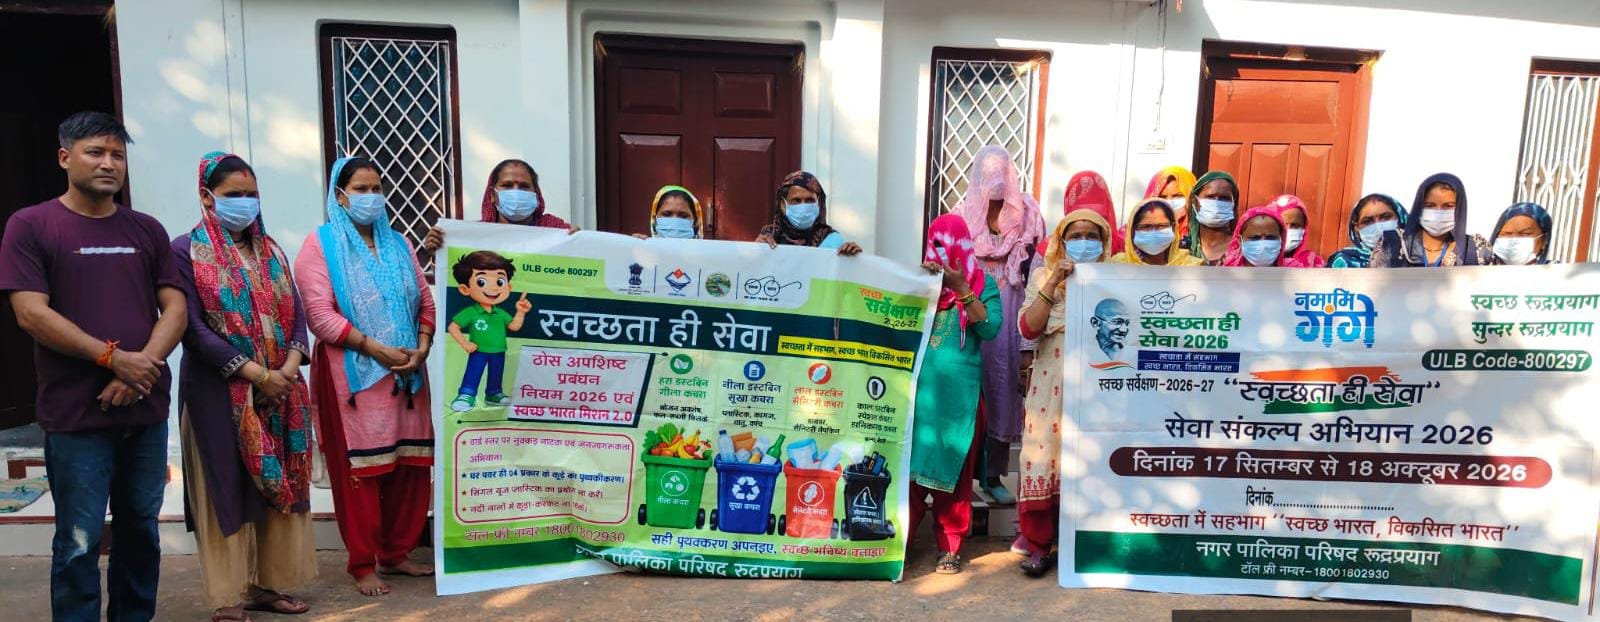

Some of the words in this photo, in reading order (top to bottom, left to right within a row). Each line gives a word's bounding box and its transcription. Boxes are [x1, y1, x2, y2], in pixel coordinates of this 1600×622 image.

[522, 263, 541, 273] ULB
[543, 264, 564, 275] code
[568, 267, 598, 278] 800297
[864, 296, 922, 320] सर्वेक्षण
[1295, 288, 1355, 310] नमामि
[1471, 294, 1518, 310] स्वच्छ
[538, 309, 660, 343] स्वच्छता
[669, 308, 702, 347] ही
[712, 313, 772, 351] सेवा
[1140, 316, 1215, 331] स्वच्छता
[1218, 312, 1241, 331] ही
[1294, 294, 1378, 348] गंगे
[1139, 331, 1180, 348] सेवा
[1184, 335, 1228, 349] 2026
[1472, 321, 1515, 344] सुन्दर
[533, 351, 560, 367] ठोस
[567, 354, 627, 370] अपशिष्ट
[1430, 352, 1467, 368] ULB
[1472, 352, 1589, 370] Code-800297
[557, 371, 601, 385] प्रबंधन
[722, 379, 744, 390] नीला
[748, 381, 781, 392] डस्टबिन
[1099, 378, 1124, 391] स्वच्छ
[1127, 373, 1215, 392] सर्वेक्षण-2026-27
[521, 384, 563, 401] नियम
[570, 391, 607, 402] 2026
[613, 392, 634, 404] एवं
[728, 394, 748, 404] सूखा
[1342, 375, 1369, 404] ही
[514, 404, 545, 417] स्वच्छ
[550, 406, 576, 419] भारत
[579, 406, 609, 421] मिशन
[613, 411, 632, 422] 2.0
[1165, 411, 1214, 438] सेवा
[1220, 415, 1302, 442] संकल्प
[1309, 416, 1414, 444] अभियान
[1421, 424, 1494, 445] 2026
[1133, 448, 1195, 472] दिनांक
[1203, 456, 1228, 472] 17
[1236, 451, 1314, 475] सितम्बर
[1320, 454, 1339, 476] से
[1347, 460, 1373, 477] 18
[1380, 461, 1460, 486] अक्टूबर
[1467, 463, 1527, 481] 2026
[1130, 512, 1189, 528] स्वच्छता
[1194, 509, 1206, 528] में
[1211, 513, 1267, 530] सहभाग
[1334, 517, 1381, 538] भारत,
[1388, 516, 1455, 538] विकसित
[651, 531, 672, 545] सही
[781, 545, 810, 555] स्वच्छ
[814, 544, 847, 557] भविष्य
[851, 547, 887, 558] बनाइए
[1196, 541, 1231, 557] नगर
[1237, 538, 1300, 560] पालिका
[1305, 541, 1359, 562] परिषद
[679, 556, 728, 576] परिषद
[1241, 561, 1260, 575] टॉल
[1262, 564, 1276, 575] फ्री
